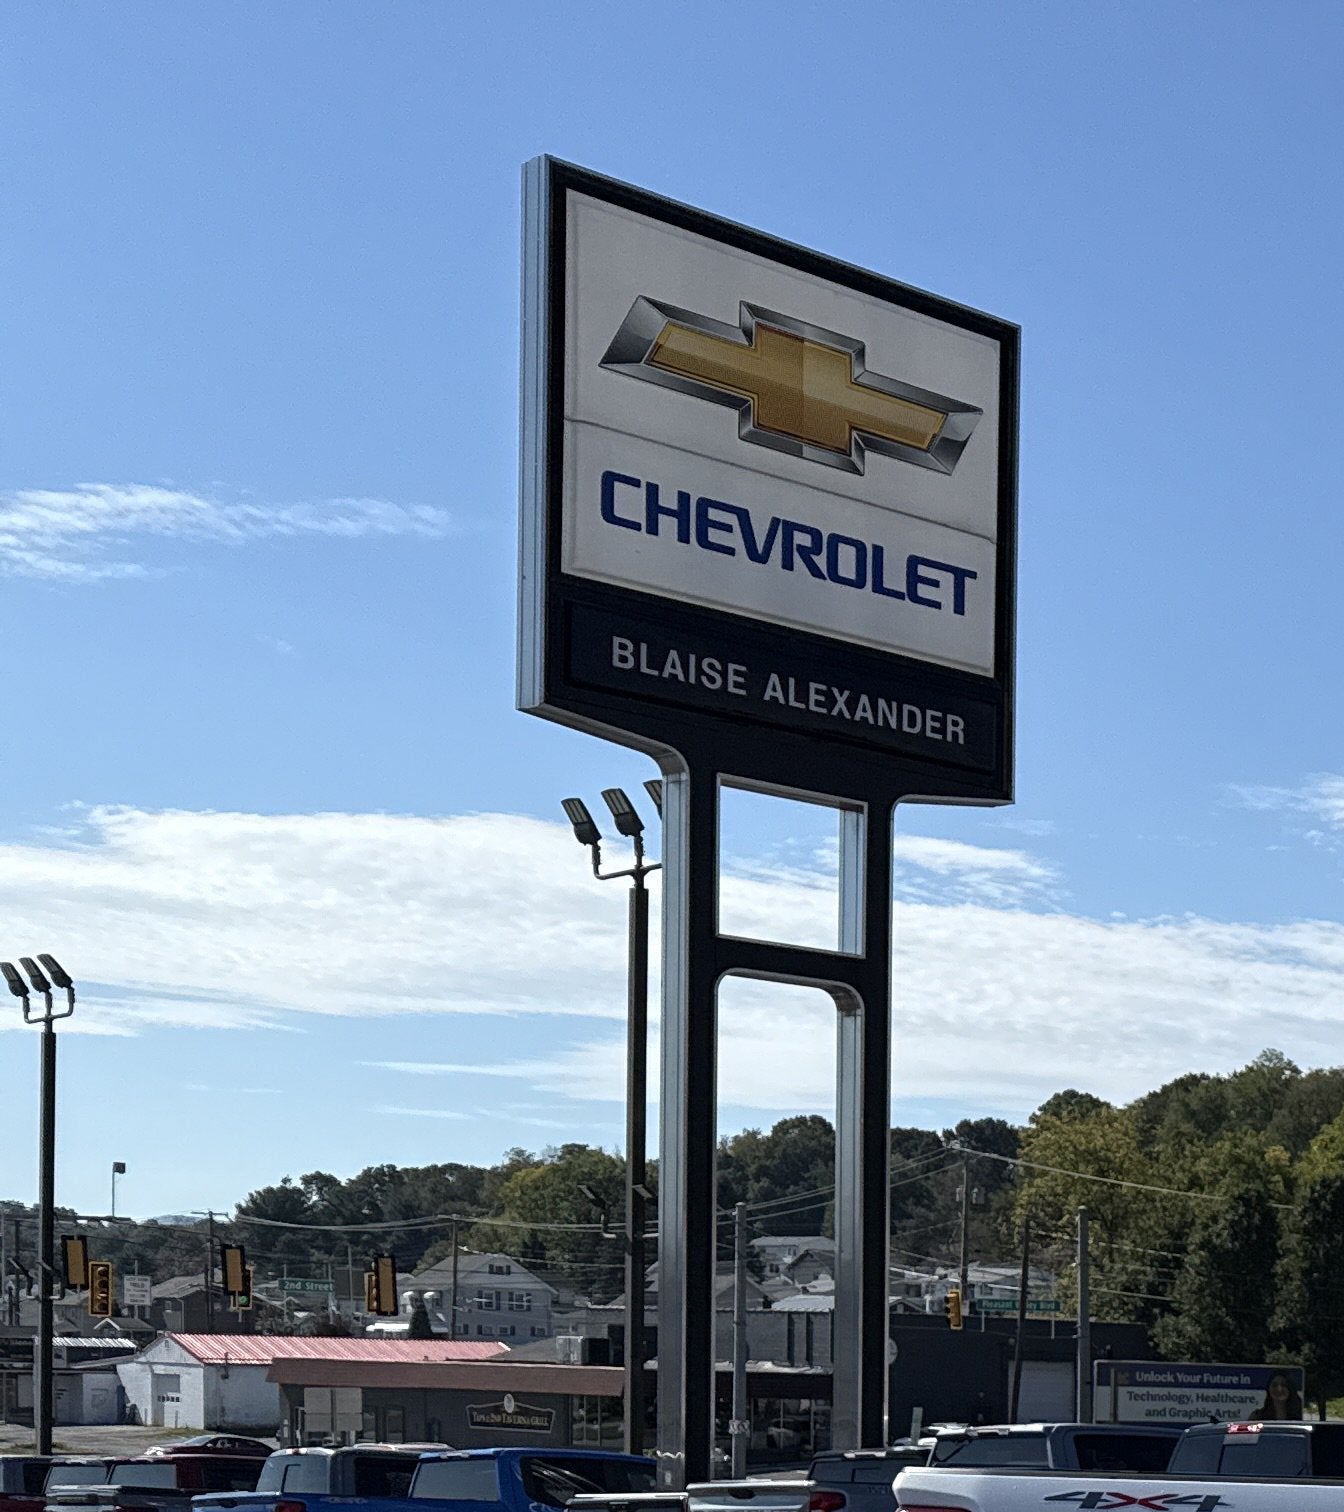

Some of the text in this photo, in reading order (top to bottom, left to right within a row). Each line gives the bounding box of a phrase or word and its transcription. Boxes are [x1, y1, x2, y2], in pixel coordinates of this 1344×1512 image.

[600, 470, 977, 616] CHEVROLET
[611, 636, 966, 745] BLAISE ALEXANDER
[284, 1281, 333, 1291] 2nd Street
[1135, 1371, 1251, 1384] Unlock Your Future in
[1127, 1391, 1259, 1406] Technology, Healthcare,
[1144, 1407, 1167, 1418] and
[1169, 1408, 1212, 1419] Graphic
